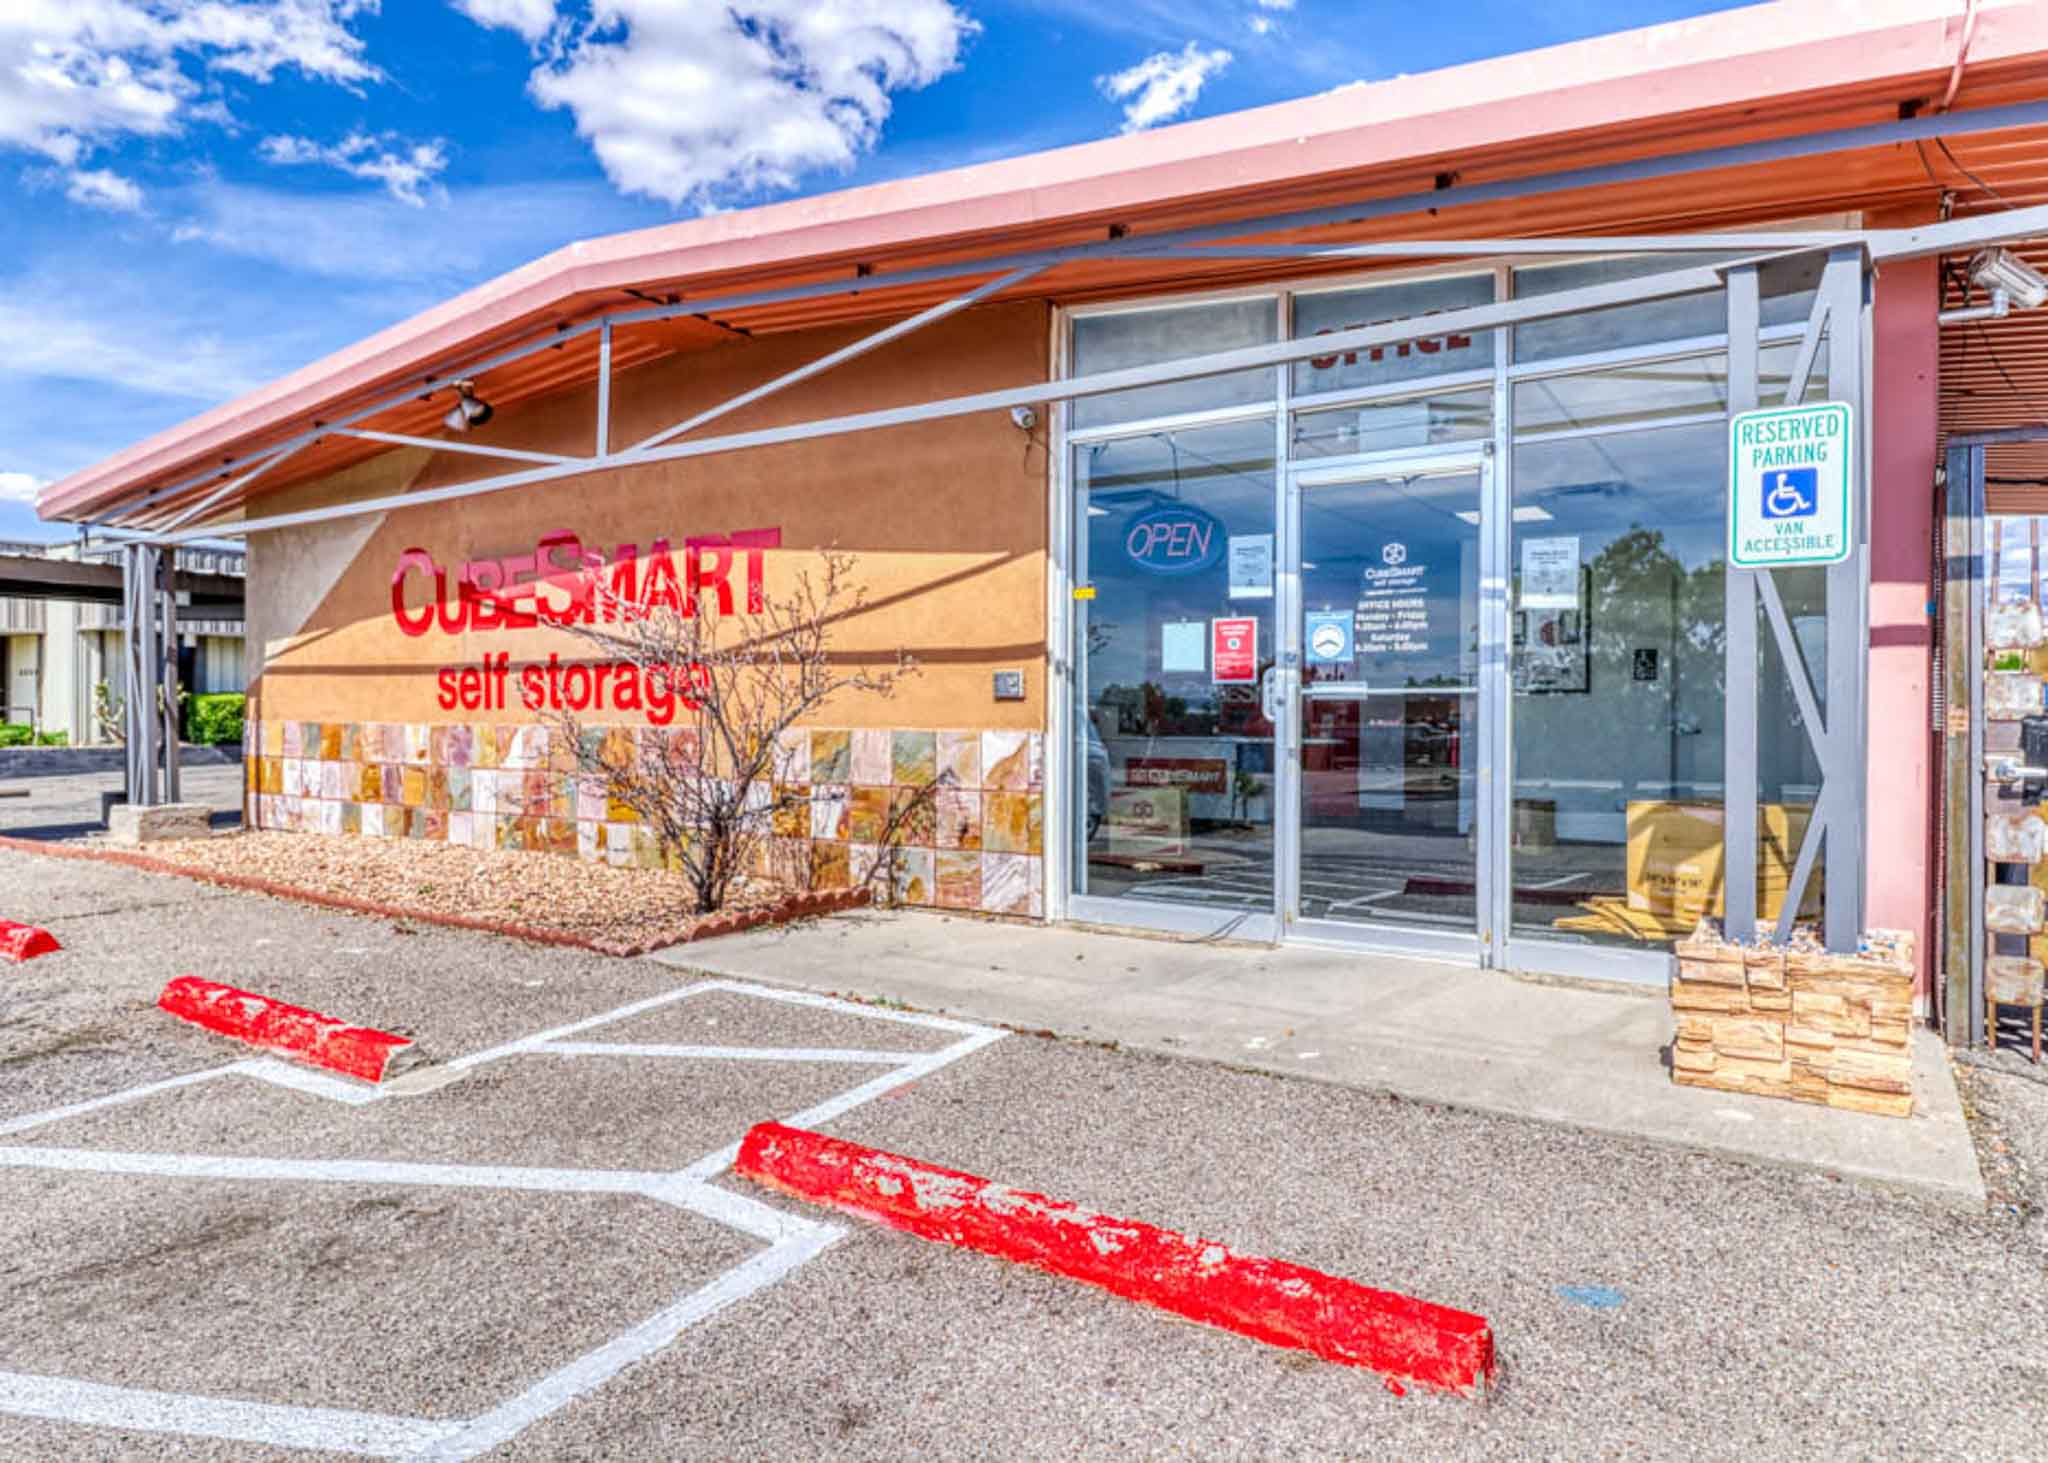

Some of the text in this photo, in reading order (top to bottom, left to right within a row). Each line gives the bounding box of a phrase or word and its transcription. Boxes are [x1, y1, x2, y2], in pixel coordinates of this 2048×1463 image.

[1742, 413, 1839, 446] RESERVED
[1753, 442, 1828, 468] PARKING
[1126, 521, 1214, 560] OPEN
[1774, 521, 1805, 536] VAN
[1744, 534, 1835, 553] ACCESSIBLE
[437, 651, 714, 726] self storage
